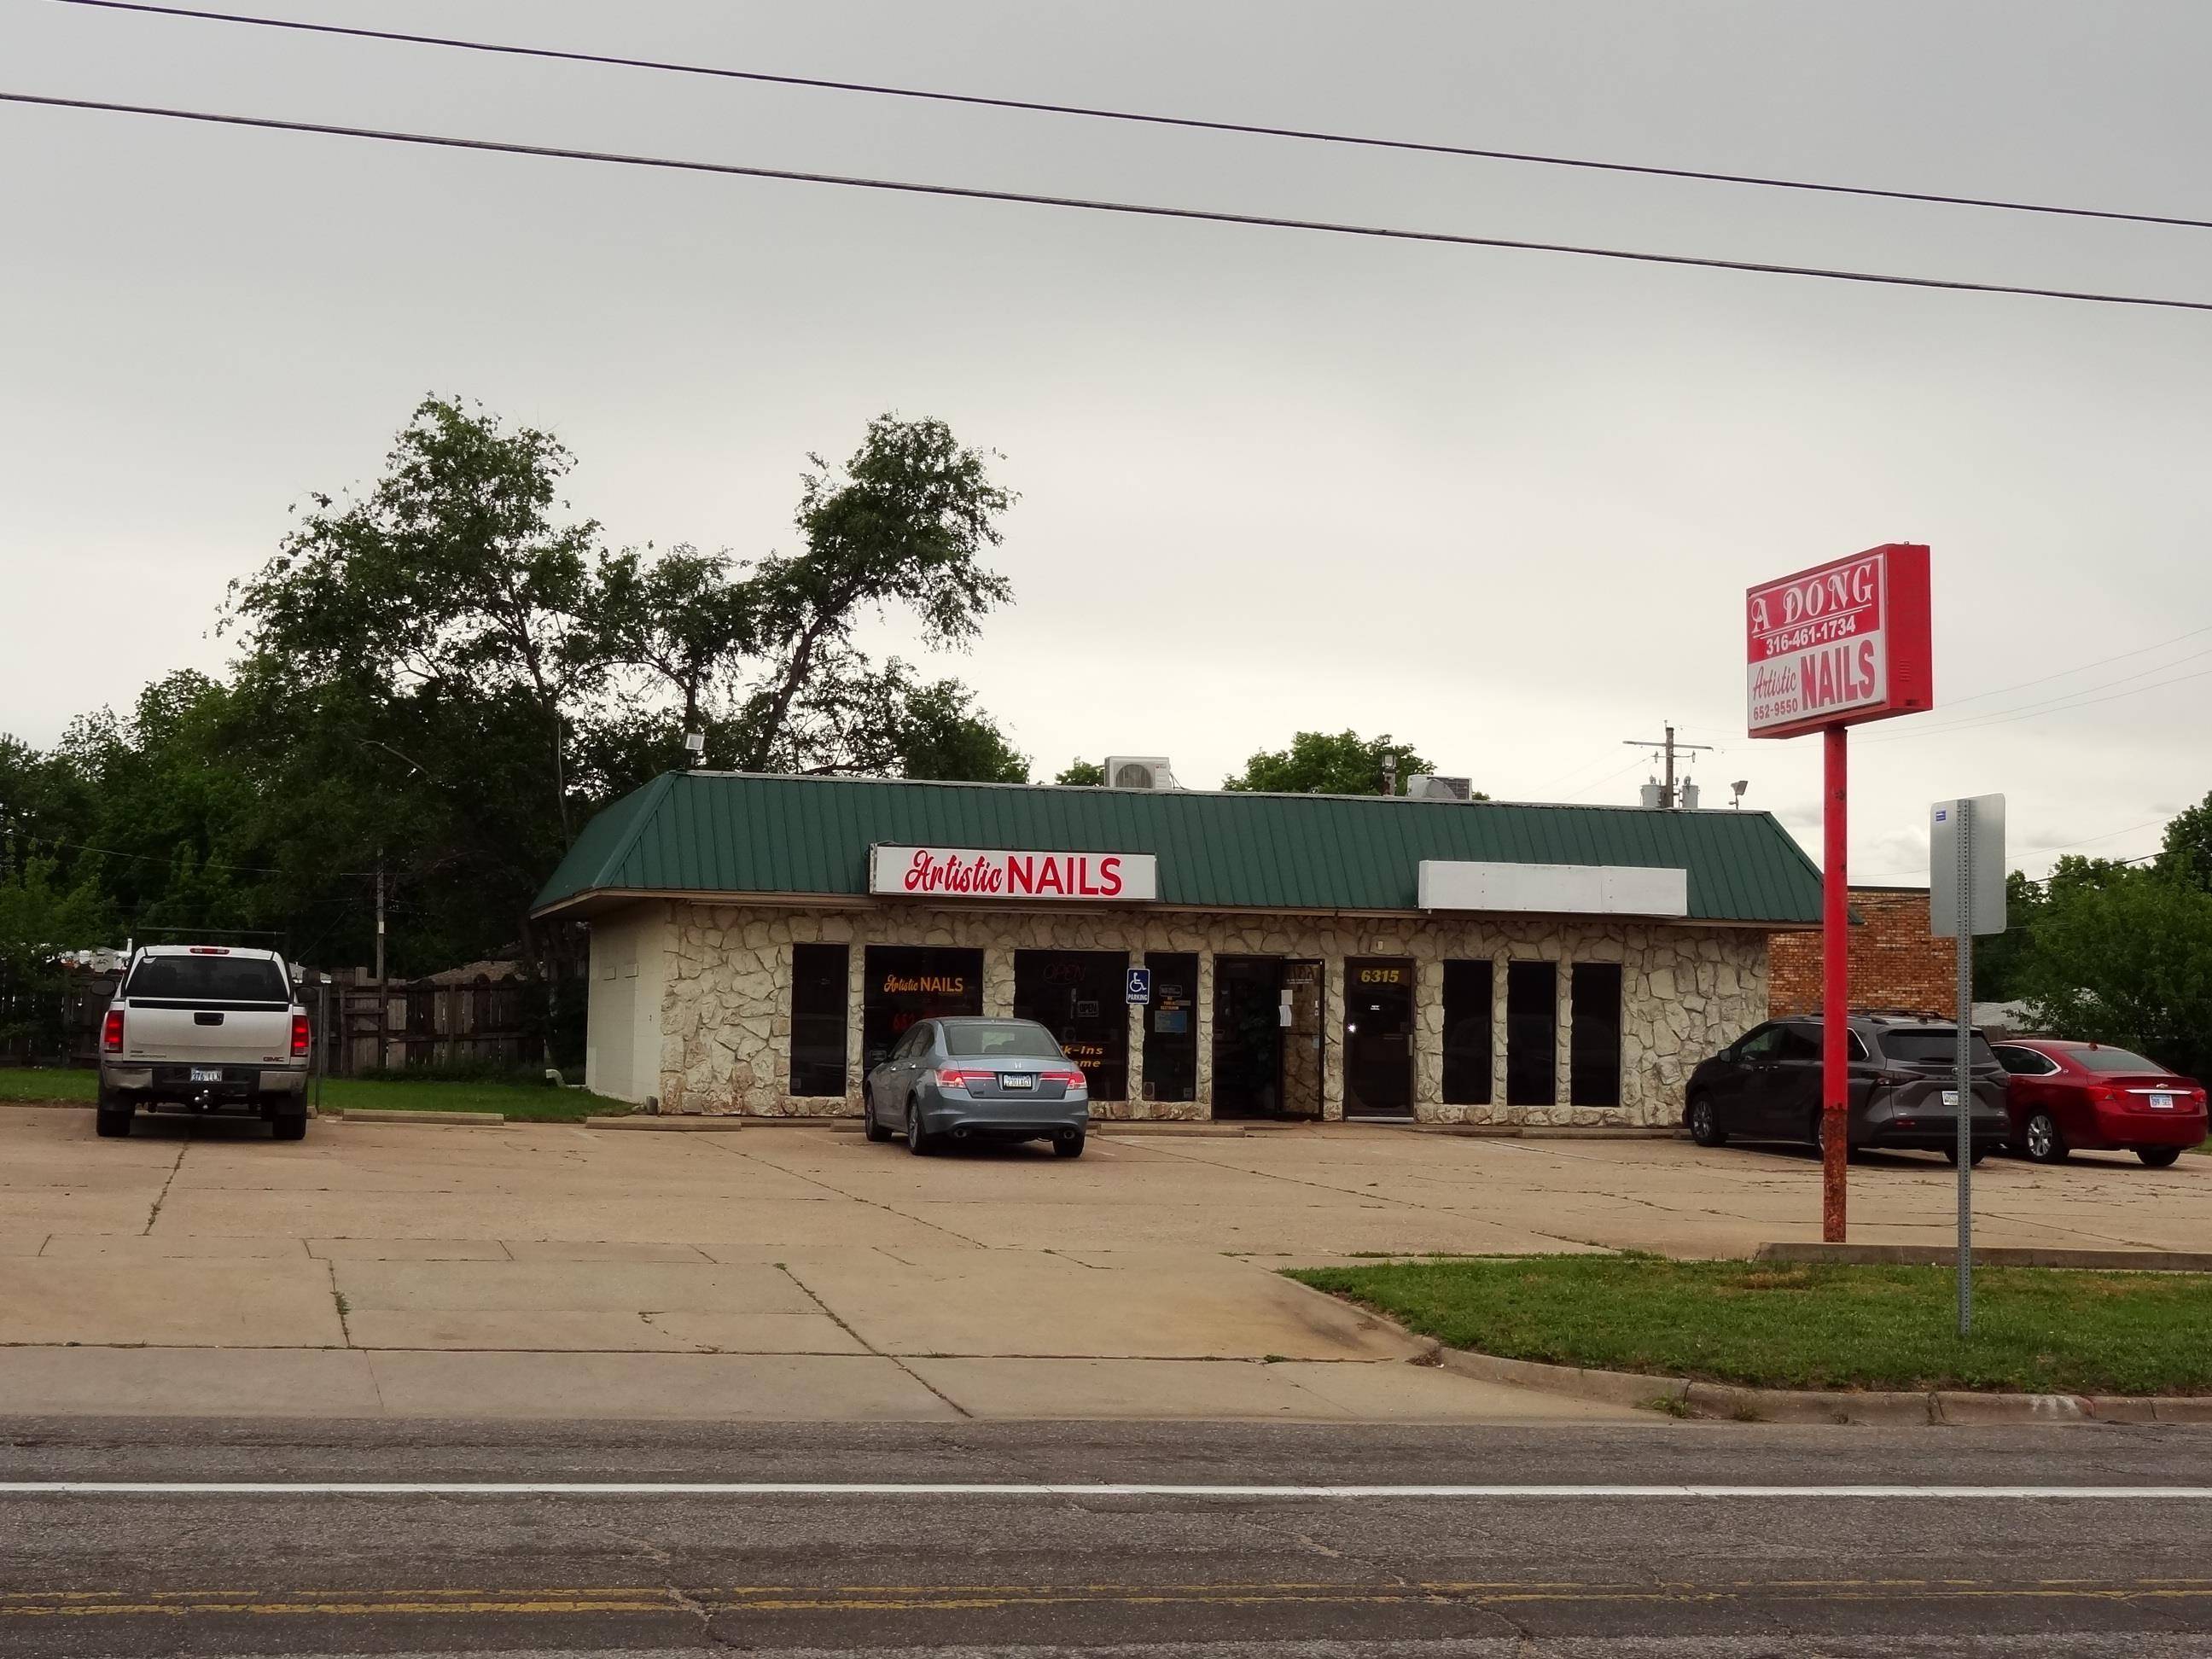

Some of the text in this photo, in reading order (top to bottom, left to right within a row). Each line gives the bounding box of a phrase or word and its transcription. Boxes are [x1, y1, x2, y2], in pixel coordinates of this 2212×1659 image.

[1751, 563, 1874, 634] A DONG
[1766, 614, 1856, 655] 316-461-1734
[1753, 639, 1876, 711] Artistic NAILS
[1753, 699, 1798, 720] 652-9550
[905, 849, 1122, 896] Artistic NAILS
[883, 974, 963, 992] Artistic NAILS
[1361, 969, 1400, 982] 6315
